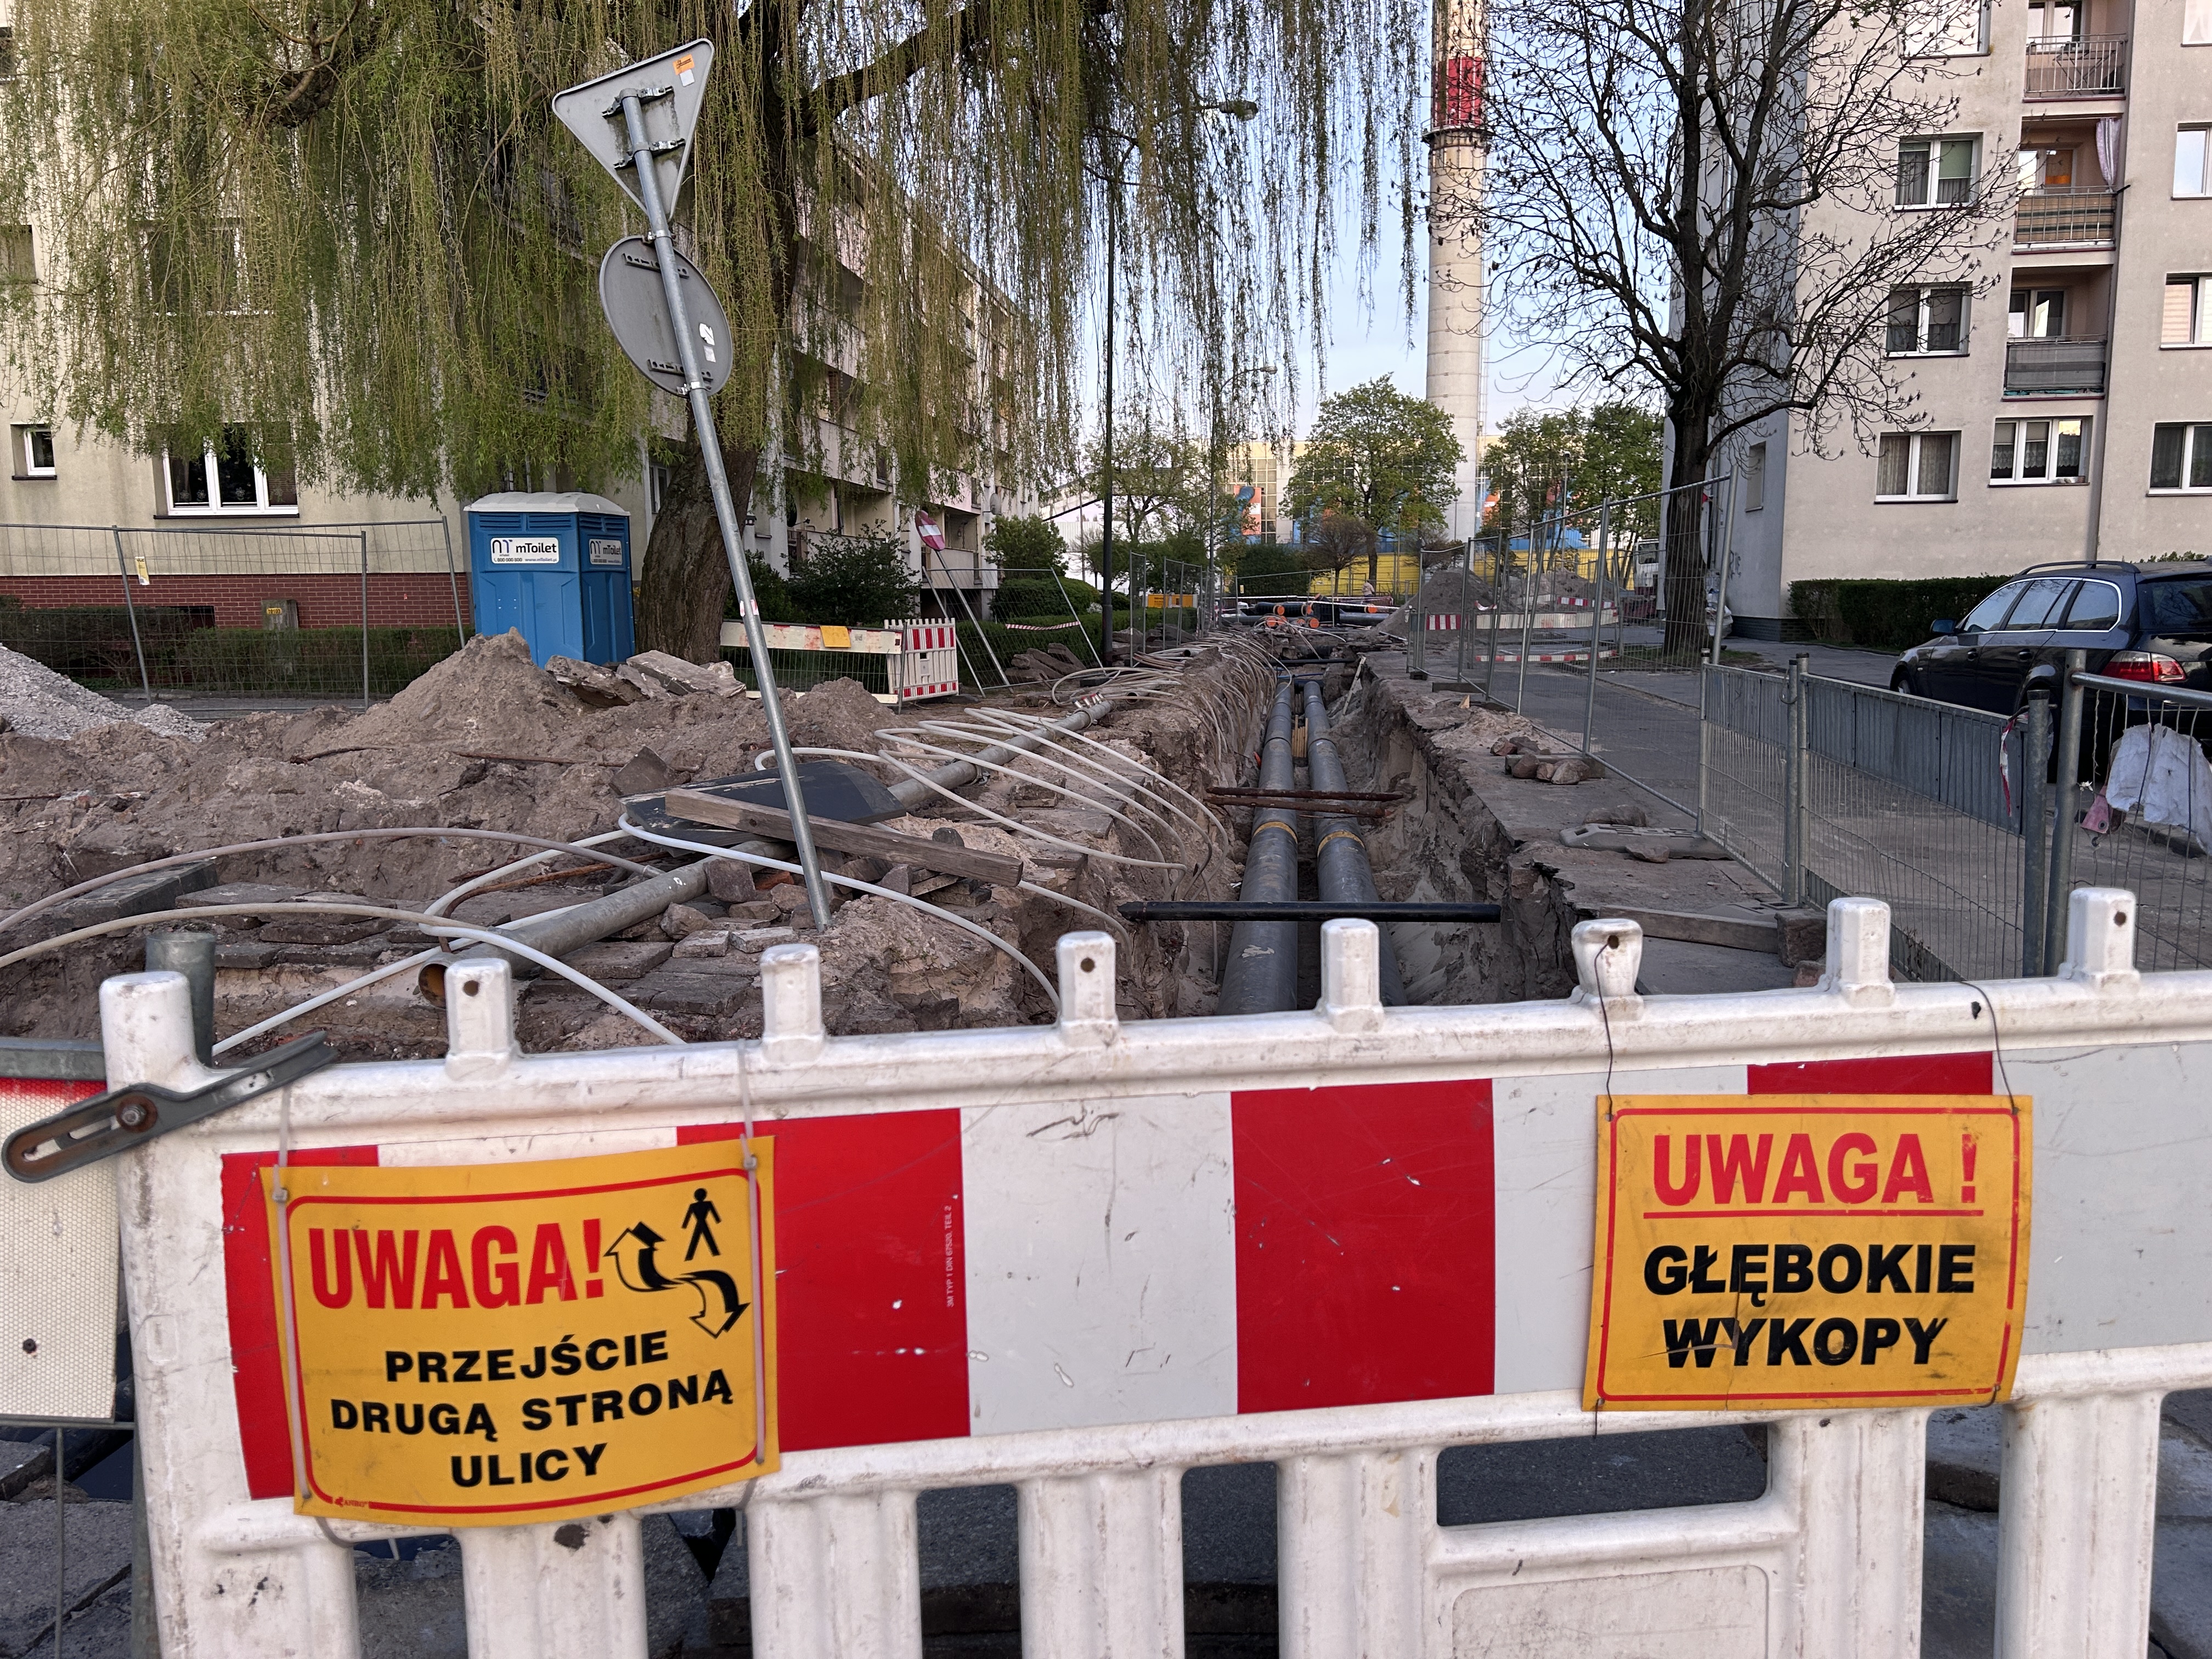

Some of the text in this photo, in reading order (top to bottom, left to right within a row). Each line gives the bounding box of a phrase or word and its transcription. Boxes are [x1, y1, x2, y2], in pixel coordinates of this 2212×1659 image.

[516, 543, 557, 552] mToilet
[603, 545, 621, 555] mToilet
[1654, 1132, 1934, 1206] UWAGA
[308, 1217, 604, 1310] UWAGA!
[1644, 1243, 1976, 1307] GŁĘBOKIE
[385, 1329, 669, 1382] PRZEJŚCIE
[1662, 1317, 1948, 1368] WYKOPY
[331, 1369, 734, 1442] DRUGĄ STRONĄ
[450, 1442, 607, 1487] ULICY
